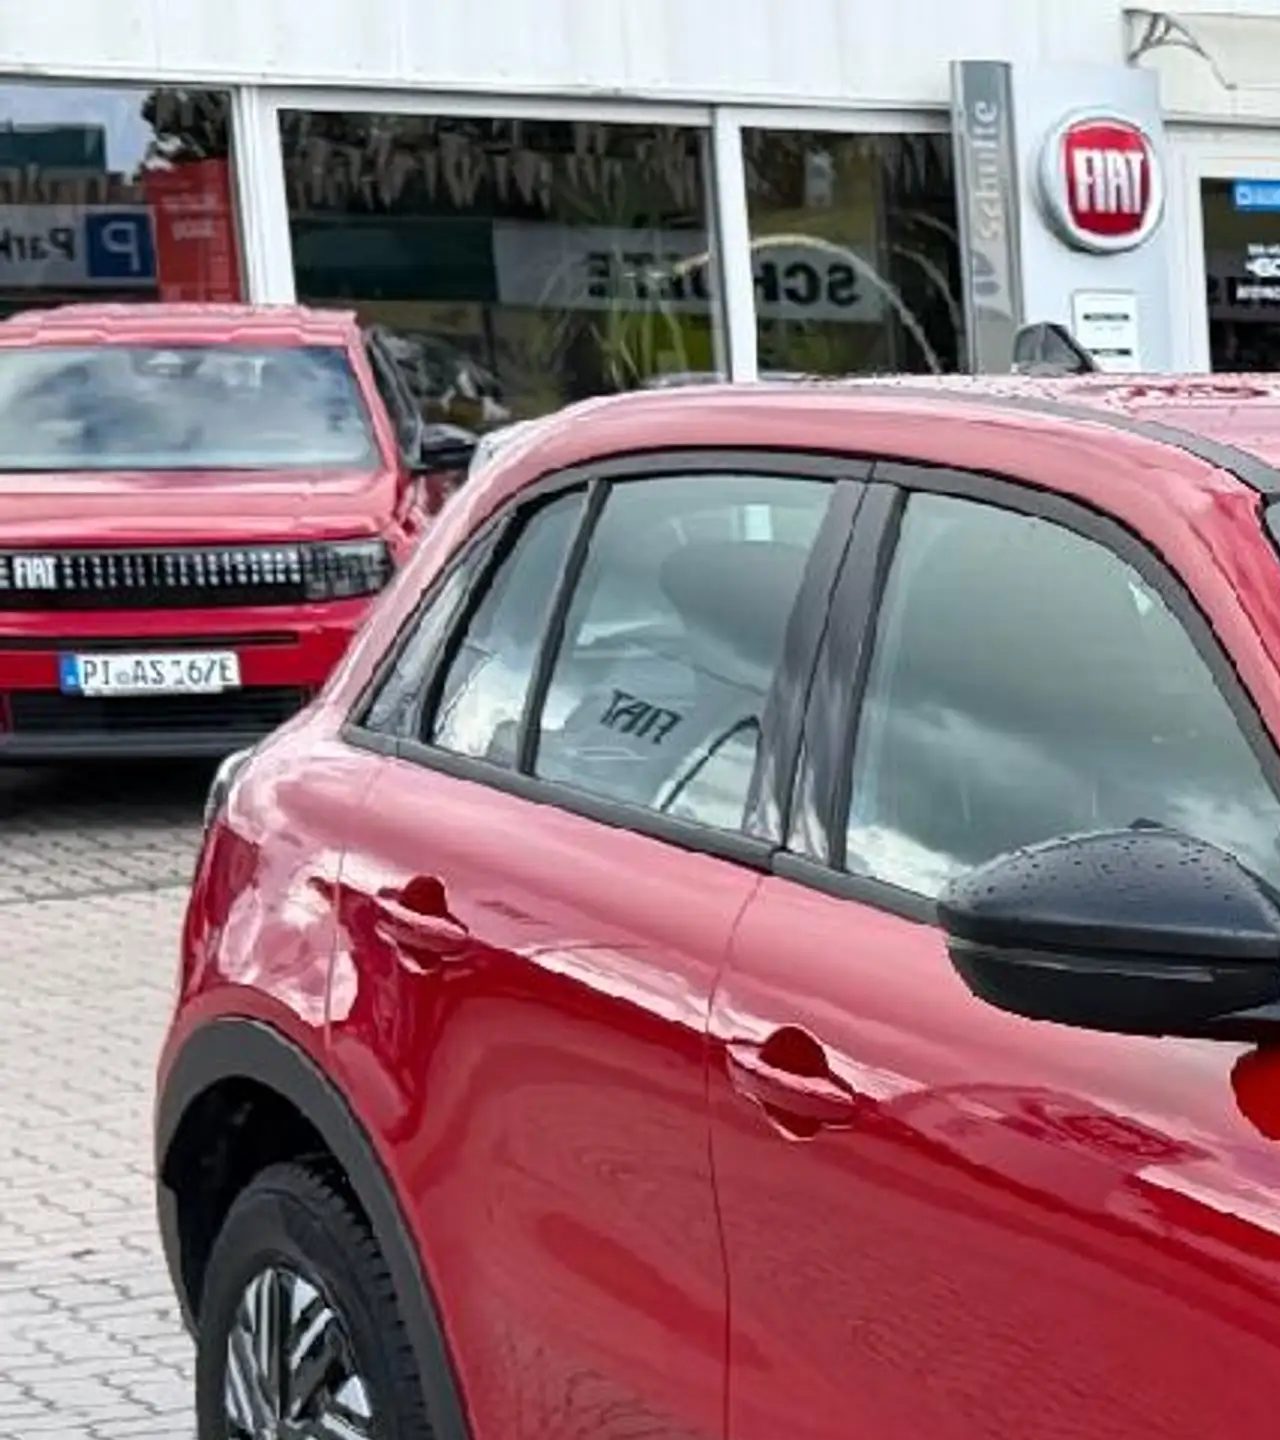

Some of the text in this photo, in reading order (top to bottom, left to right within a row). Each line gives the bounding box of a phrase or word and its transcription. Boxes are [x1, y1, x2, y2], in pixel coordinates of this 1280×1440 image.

[1072, 147, 1145, 215] FIAT
[12, 555, 57, 589] FIAT
[83, 660, 110, 686] PI
[132, 660, 165, 685] AS
